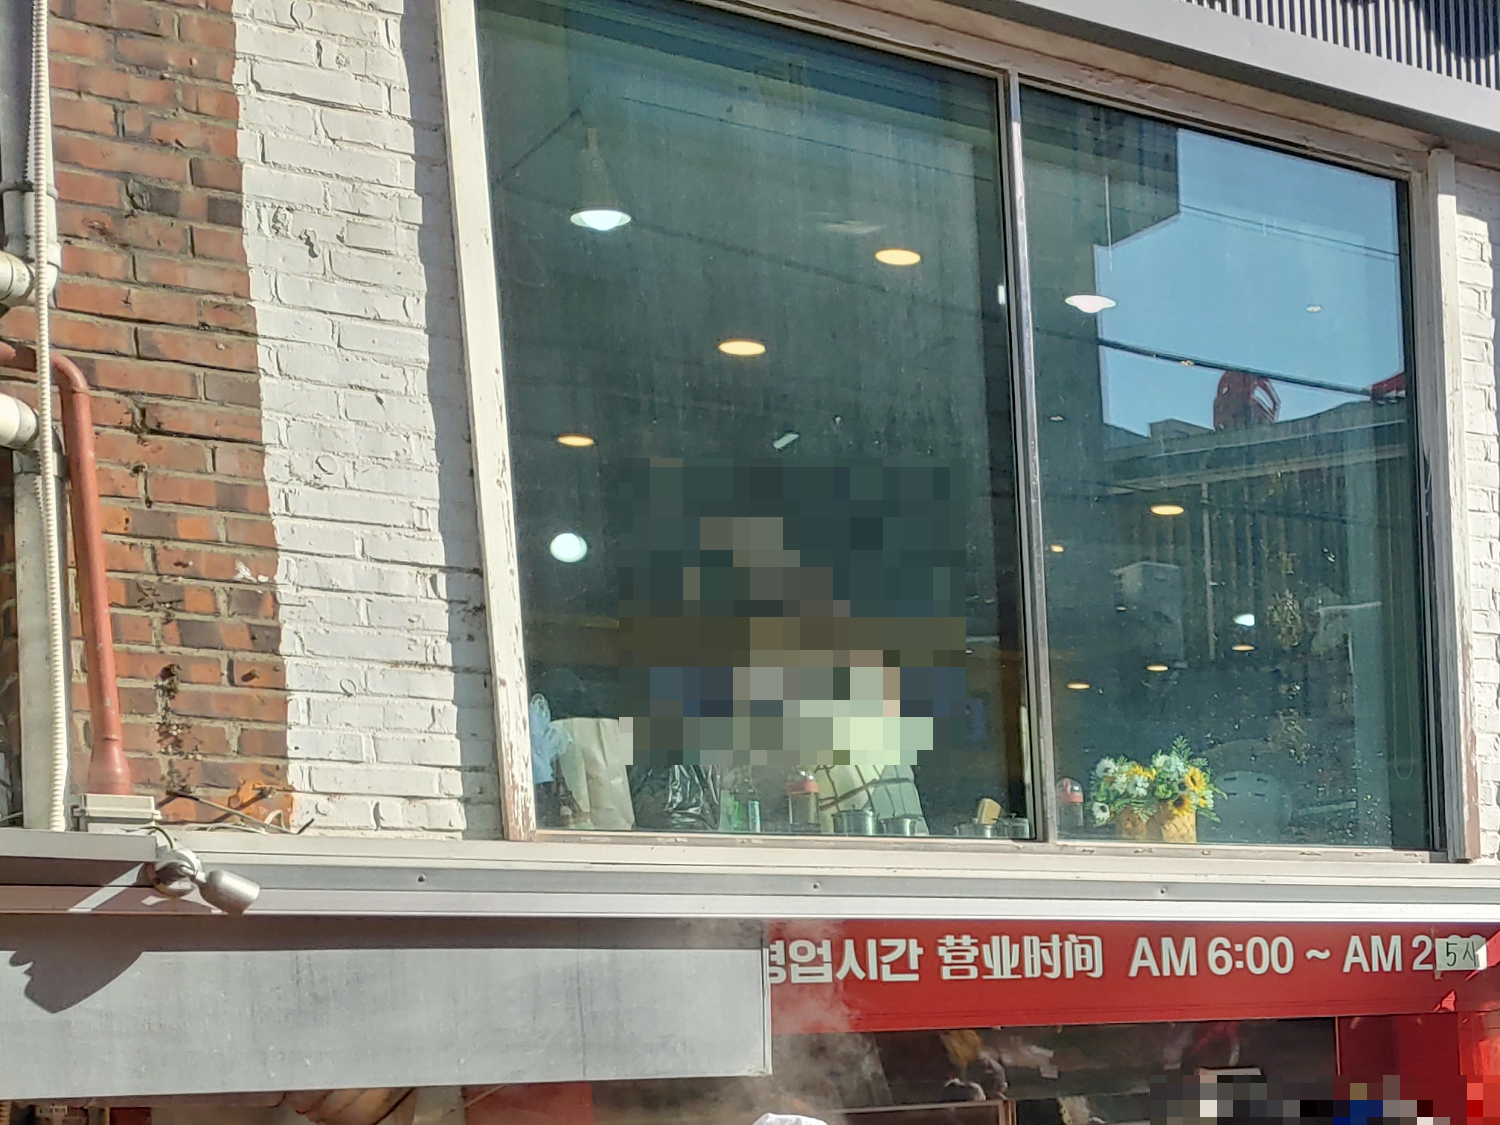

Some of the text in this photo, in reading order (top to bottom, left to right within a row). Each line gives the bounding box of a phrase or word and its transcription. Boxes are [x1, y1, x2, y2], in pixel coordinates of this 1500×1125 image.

[936, 934, 1104, 980] 营业时间
[1128, 936, 1198, 977] AM
[1207, 936, 1295, 975] 6:00
[1342, 935, 1403, 973] AM
